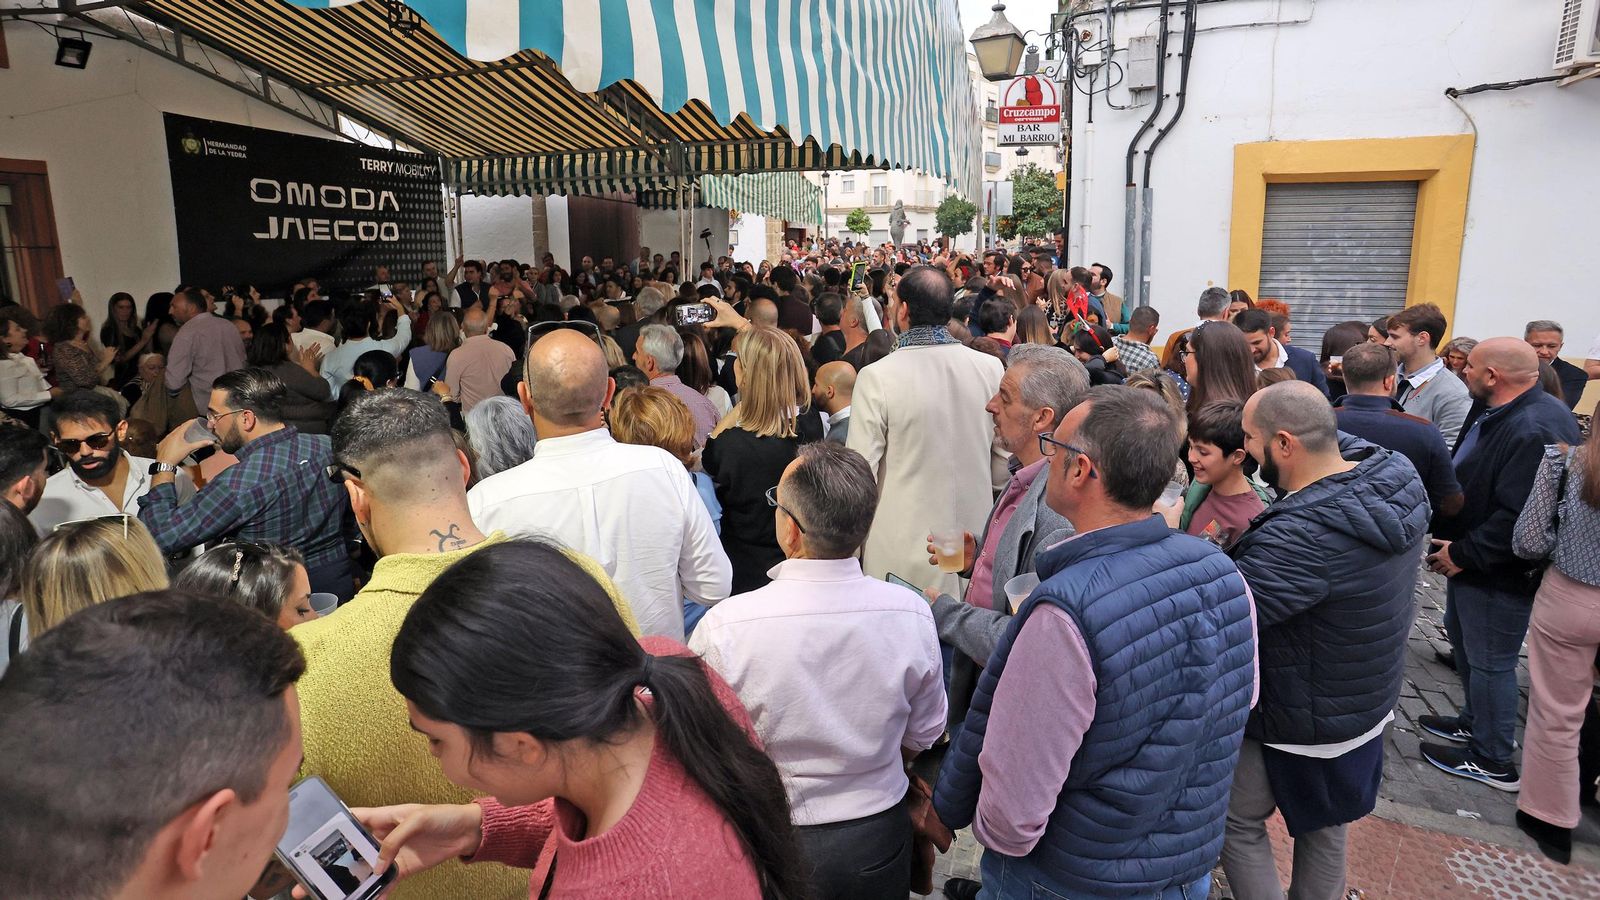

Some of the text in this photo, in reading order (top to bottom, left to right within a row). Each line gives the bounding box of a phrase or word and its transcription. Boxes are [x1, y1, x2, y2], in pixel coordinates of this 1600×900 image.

[1003, 108, 1056, 118] Cruzcampo
[1017, 124, 1040, 132] BAR
[1020, 134, 1054, 142] BARRIO
[206, 140, 247, 151] HERMANDAD
[226, 150, 247, 159] YEDRA
[360, 157, 394, 173] TERRY
[250, 177, 400, 211] OMODA
[252, 216, 400, 241] JAECOO
